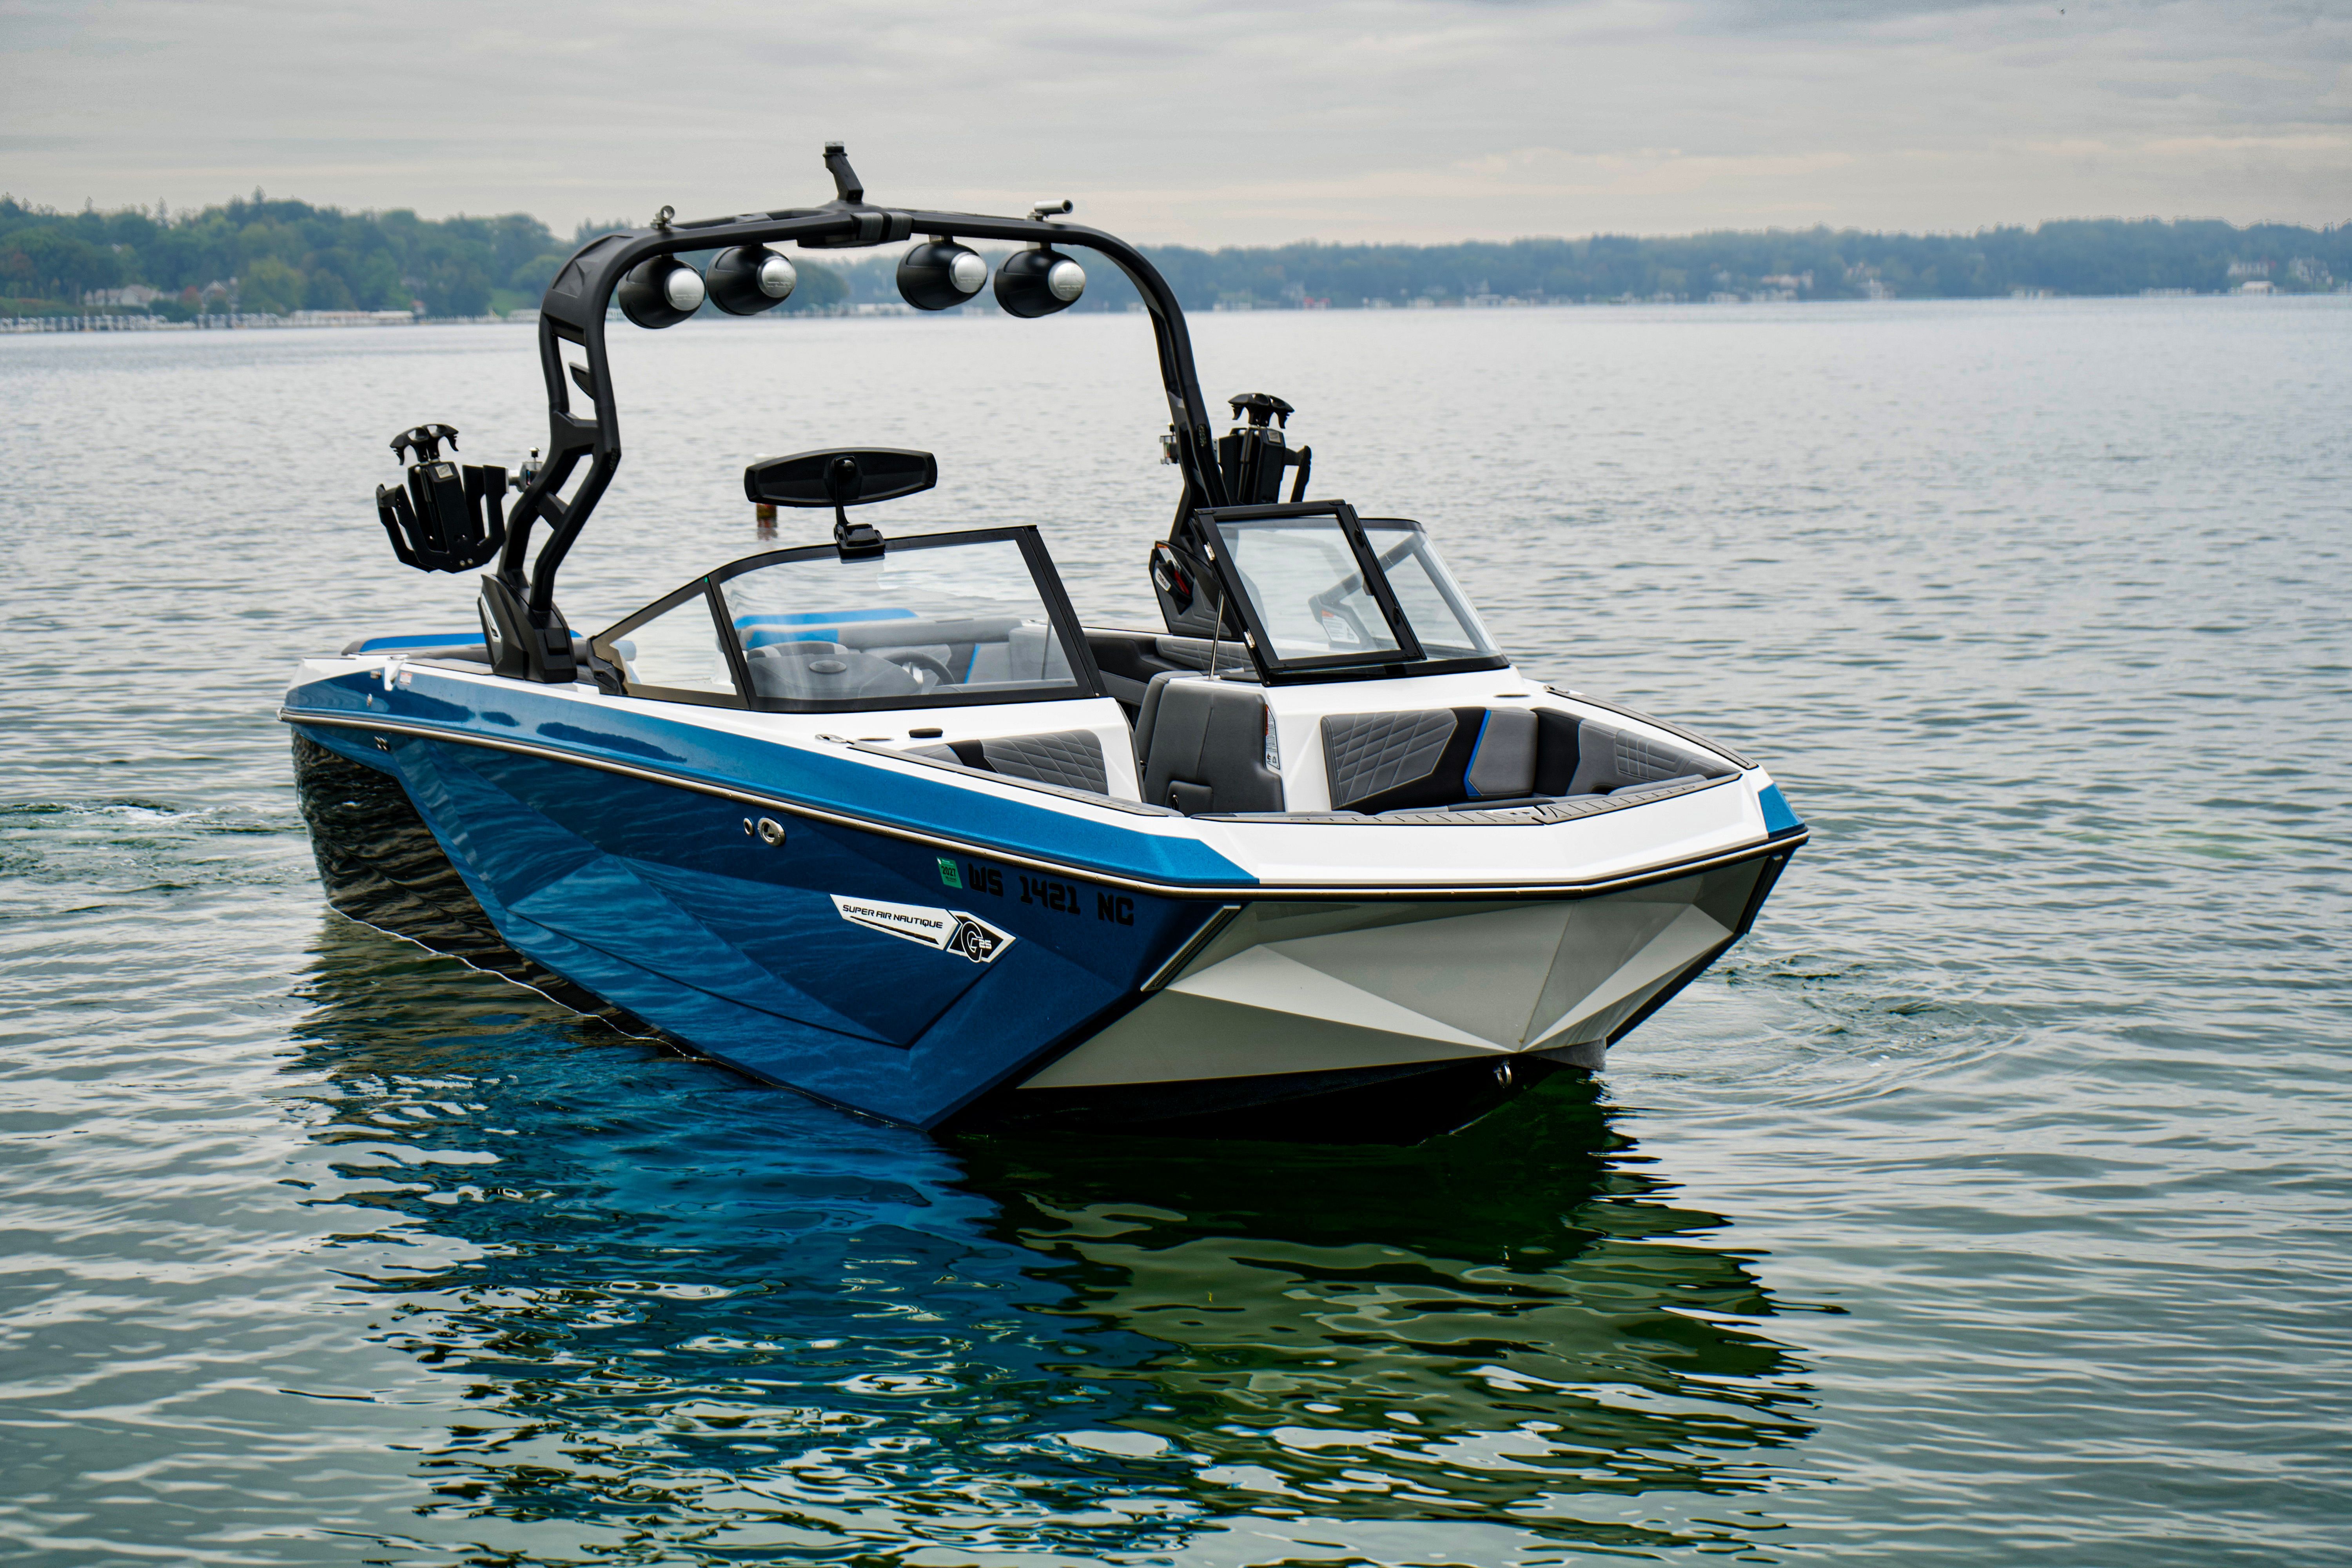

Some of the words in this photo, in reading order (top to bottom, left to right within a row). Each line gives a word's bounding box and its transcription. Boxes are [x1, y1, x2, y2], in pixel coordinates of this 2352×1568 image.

[941, 866, 956, 877] 2027
[968, 863, 1004, 897] WS
[1020, 875, 1081, 915] 1421
[1097, 891, 1134, 926] NC
[843, 905, 875, 916] SUPER
[876, 911, 892, 919] AIR
[893, 914, 943, 929] NAUTIQUE
